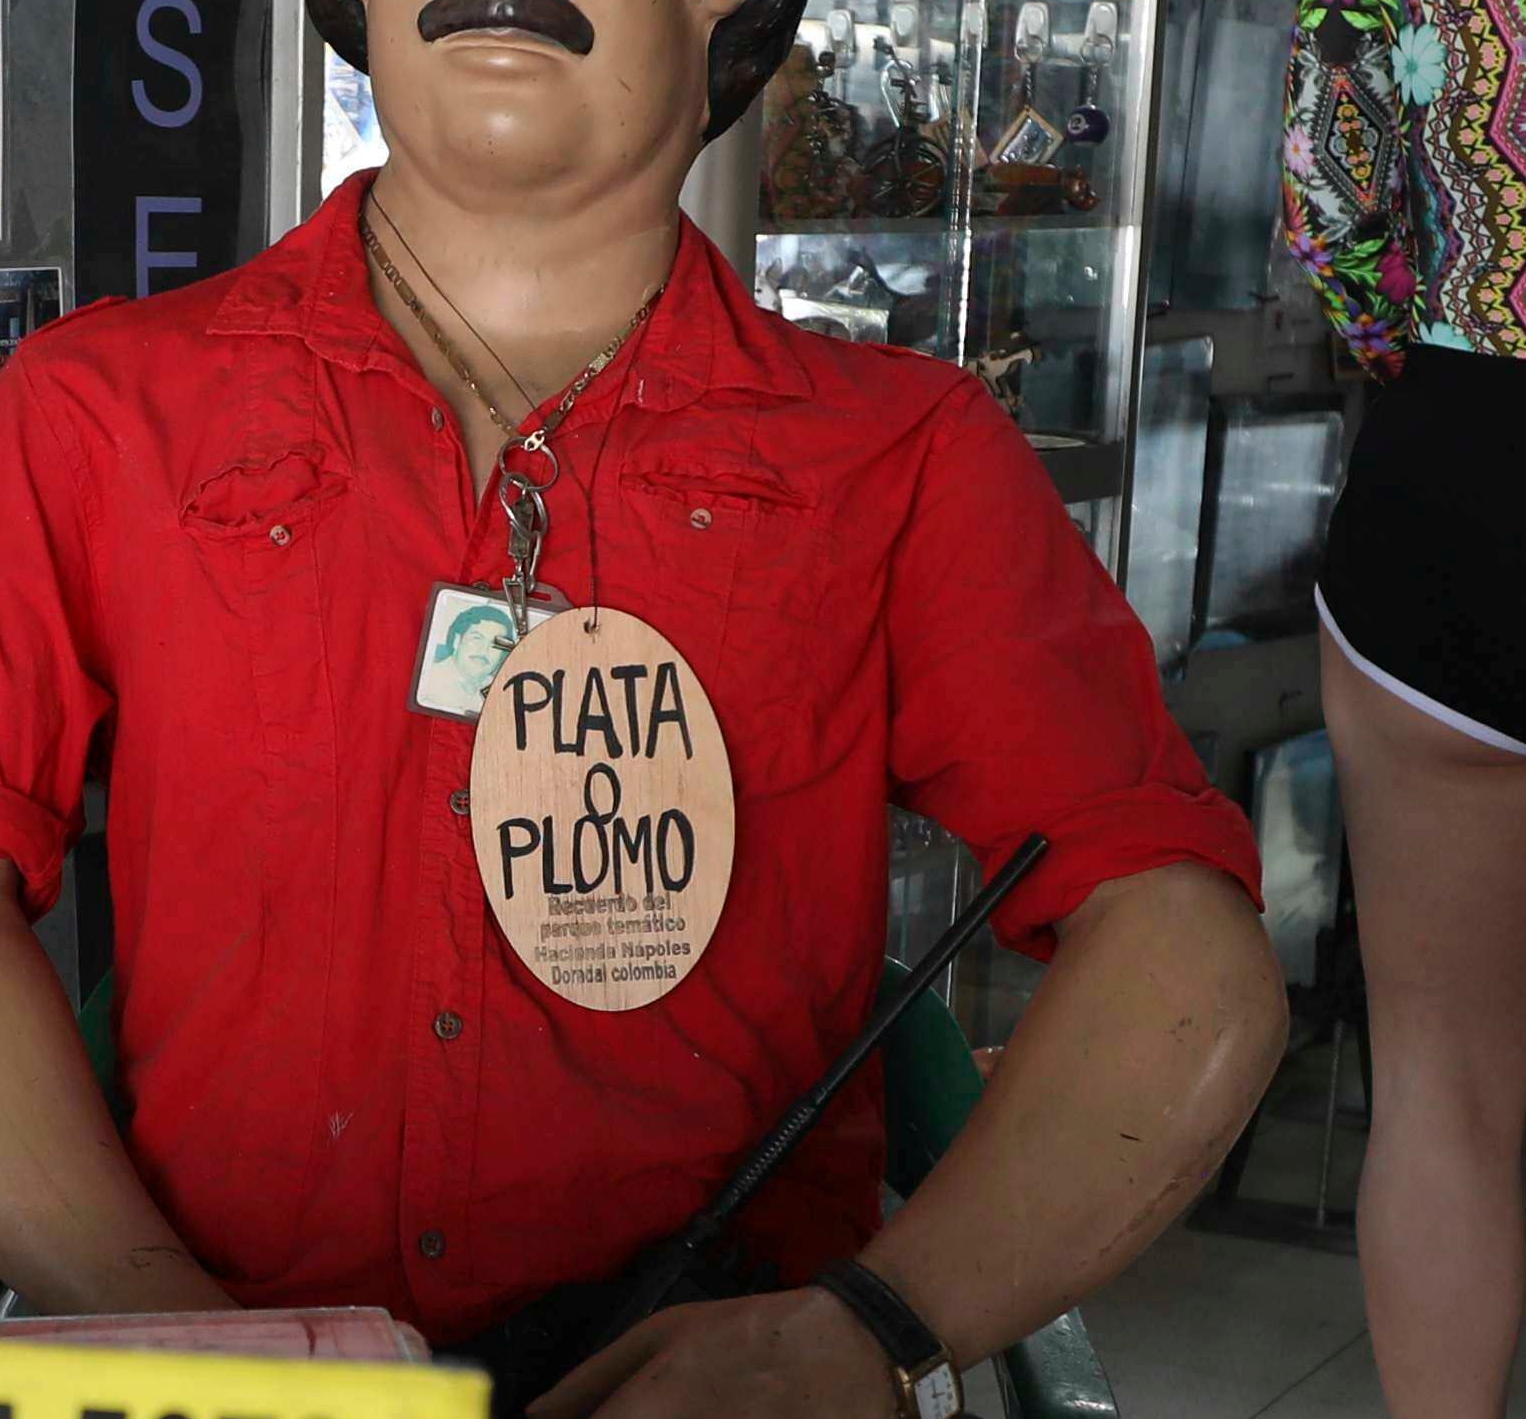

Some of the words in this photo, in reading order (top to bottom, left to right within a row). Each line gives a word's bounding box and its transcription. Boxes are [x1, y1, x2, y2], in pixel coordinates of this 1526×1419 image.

[503, 661, 693, 760] PLATA
[584, 762, 621, 826] O
[495, 808, 696, 899] PLOMO
[621, 940, 691, 961] Nápoles
